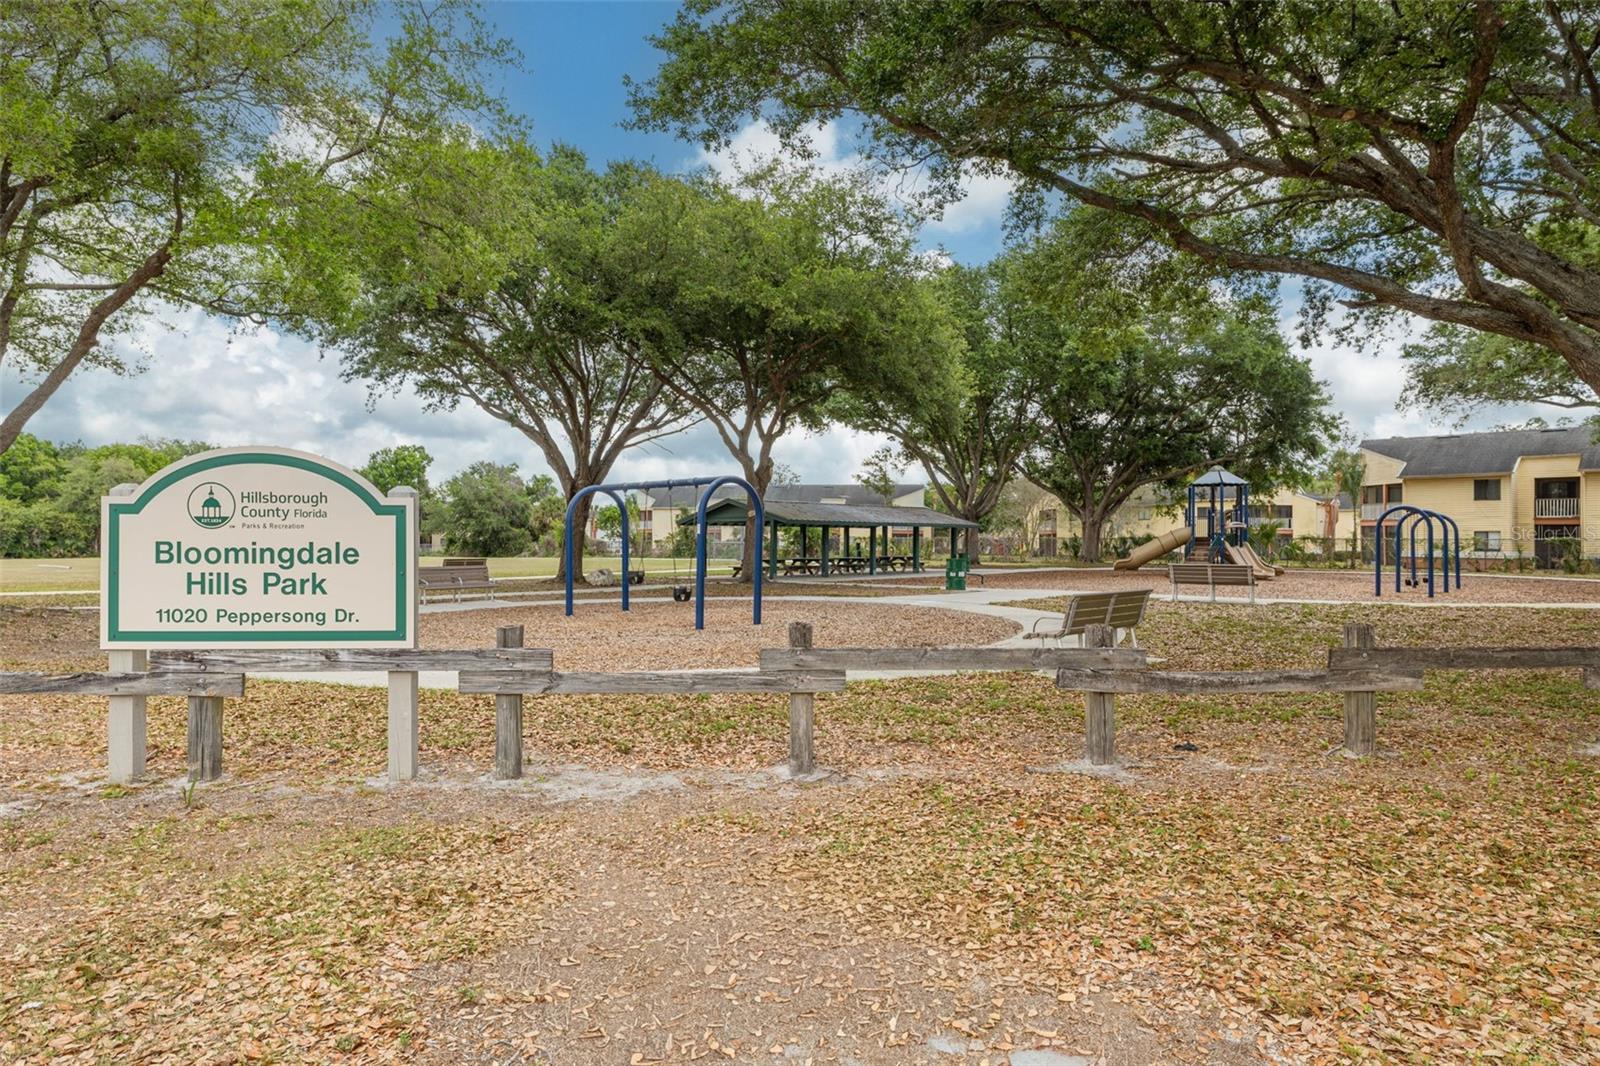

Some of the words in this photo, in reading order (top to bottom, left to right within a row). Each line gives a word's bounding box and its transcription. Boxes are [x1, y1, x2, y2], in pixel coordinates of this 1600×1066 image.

[240, 491, 328, 507] Hillsborough
[240, 506, 290, 521] County
[294, 508, 328, 518] Florida
[154, 540, 360, 570] Bloomingdale
[186, 572, 248, 595] Hills
[262, 572, 328, 595] Park
[155, 608, 208, 623] 11020
[215, 608, 326, 626] Peppersong
[334, 608, 360, 623] Dr.
